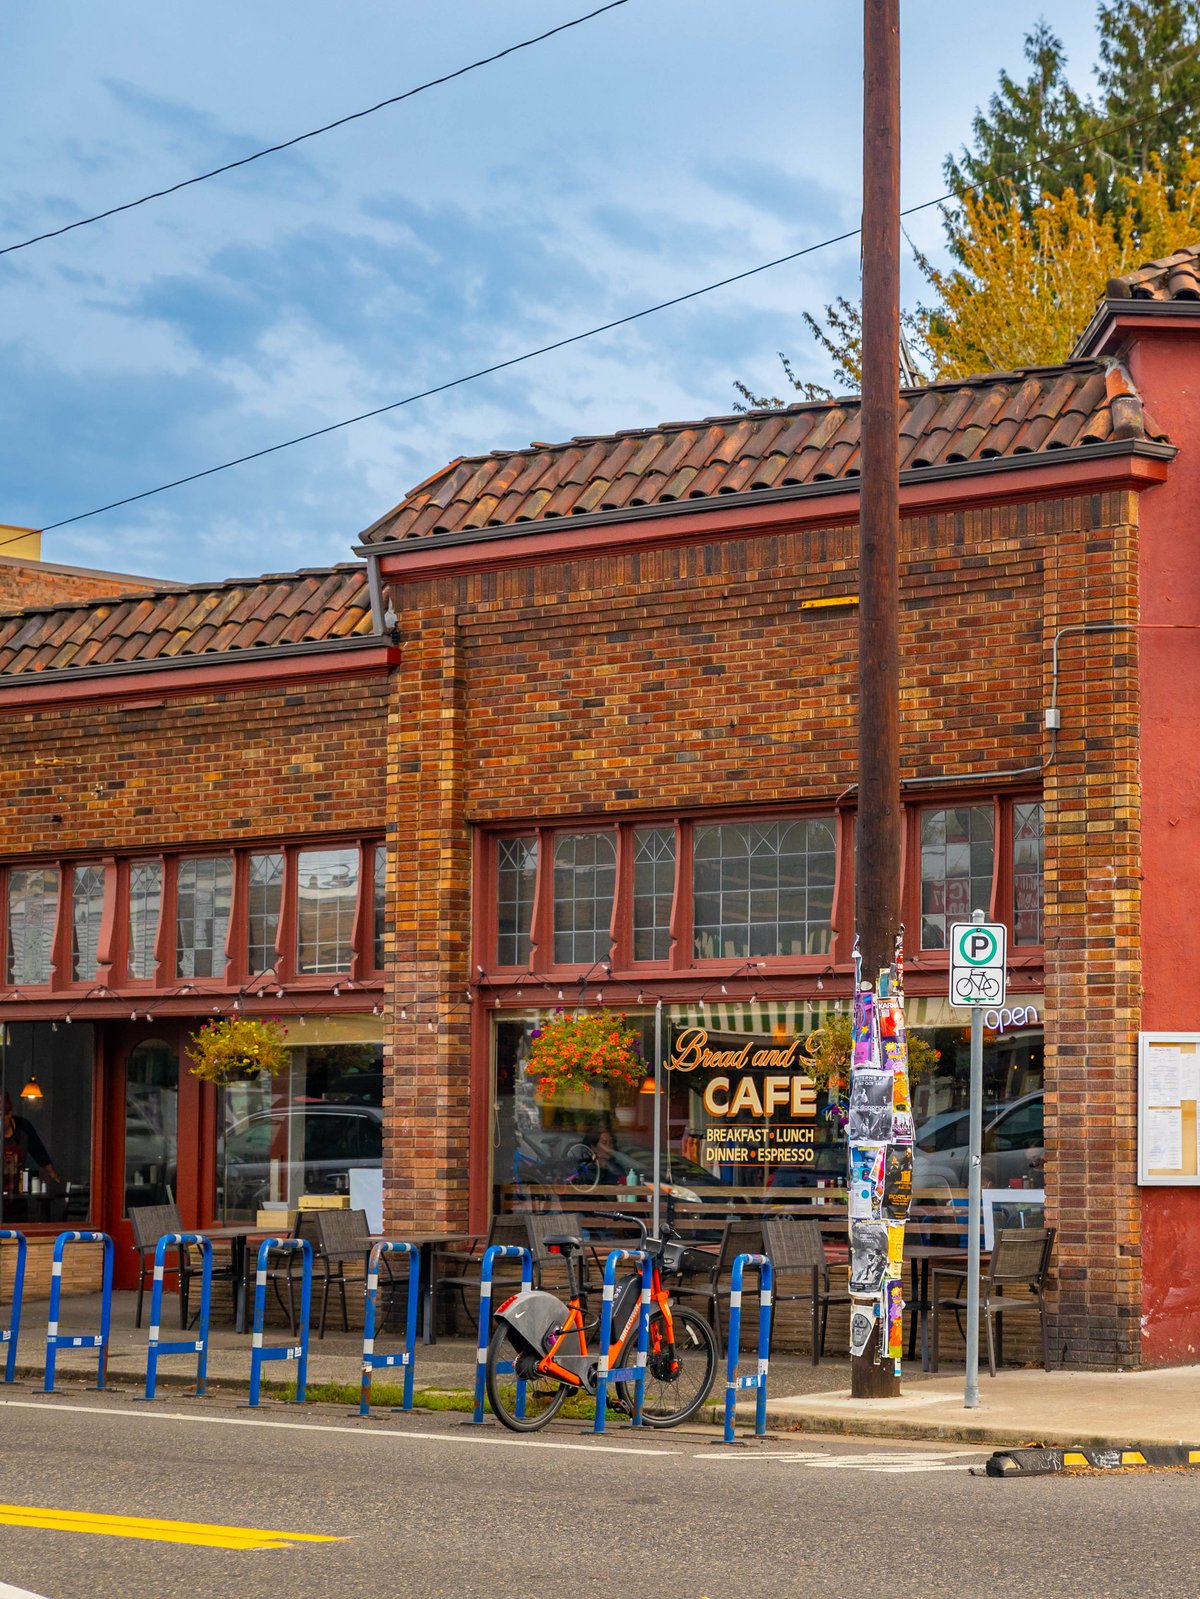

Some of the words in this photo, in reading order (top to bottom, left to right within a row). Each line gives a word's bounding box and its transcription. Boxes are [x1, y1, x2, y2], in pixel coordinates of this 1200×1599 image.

[971, 935, 989, 958] P
[985, 1005, 1038, 1033] open
[663, 1027, 755, 1073] Bread
[751, 1039, 801, 1069] and
[704, 1075, 818, 1117] CAFE
[706, 1128, 769, 1143] BREAKFAST
[776, 1128, 815, 1143] LUNCH
[706, 1147, 749, 1162] DINNER
[757, 1147, 815, 1162] ESPRESSO
